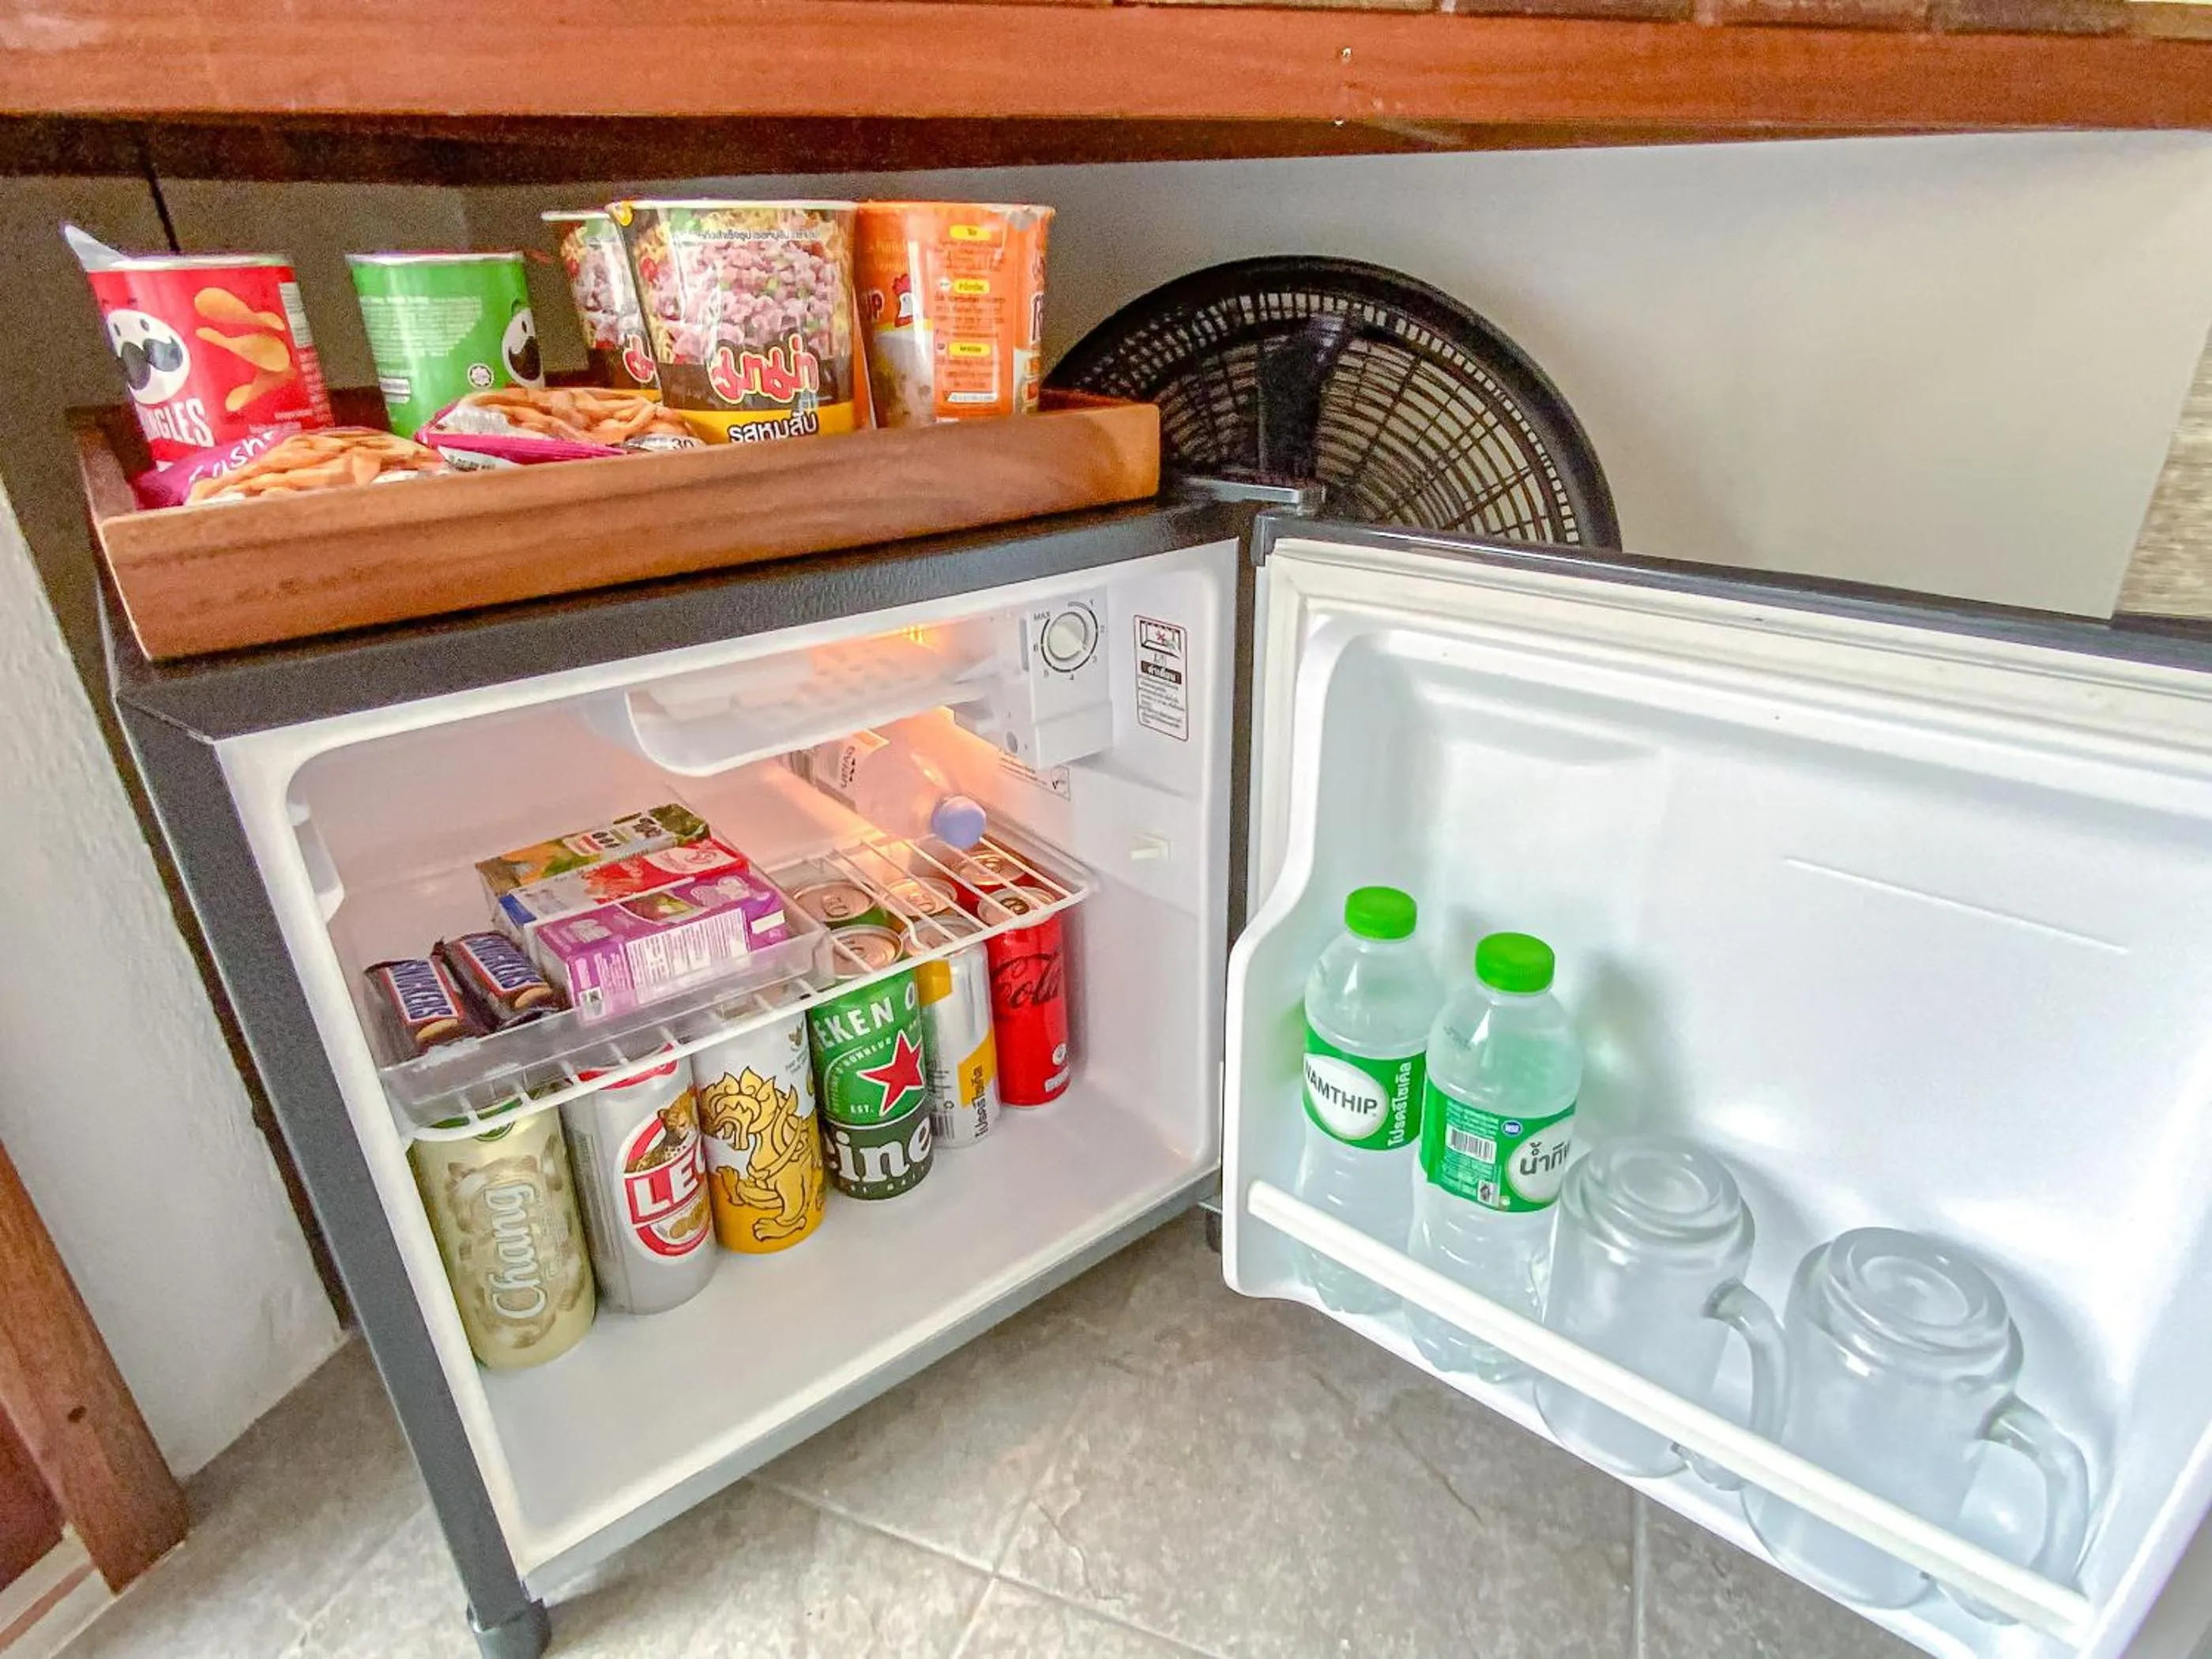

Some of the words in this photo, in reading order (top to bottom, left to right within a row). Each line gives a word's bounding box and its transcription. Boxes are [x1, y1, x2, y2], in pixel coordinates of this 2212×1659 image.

[728, 408, 818, 444] รสหมสับ
[1033, 611, 1051, 621] MAX
[1305, 1061, 1378, 1115] NAMTHIP
[485, 1184, 547, 1319] Chang
